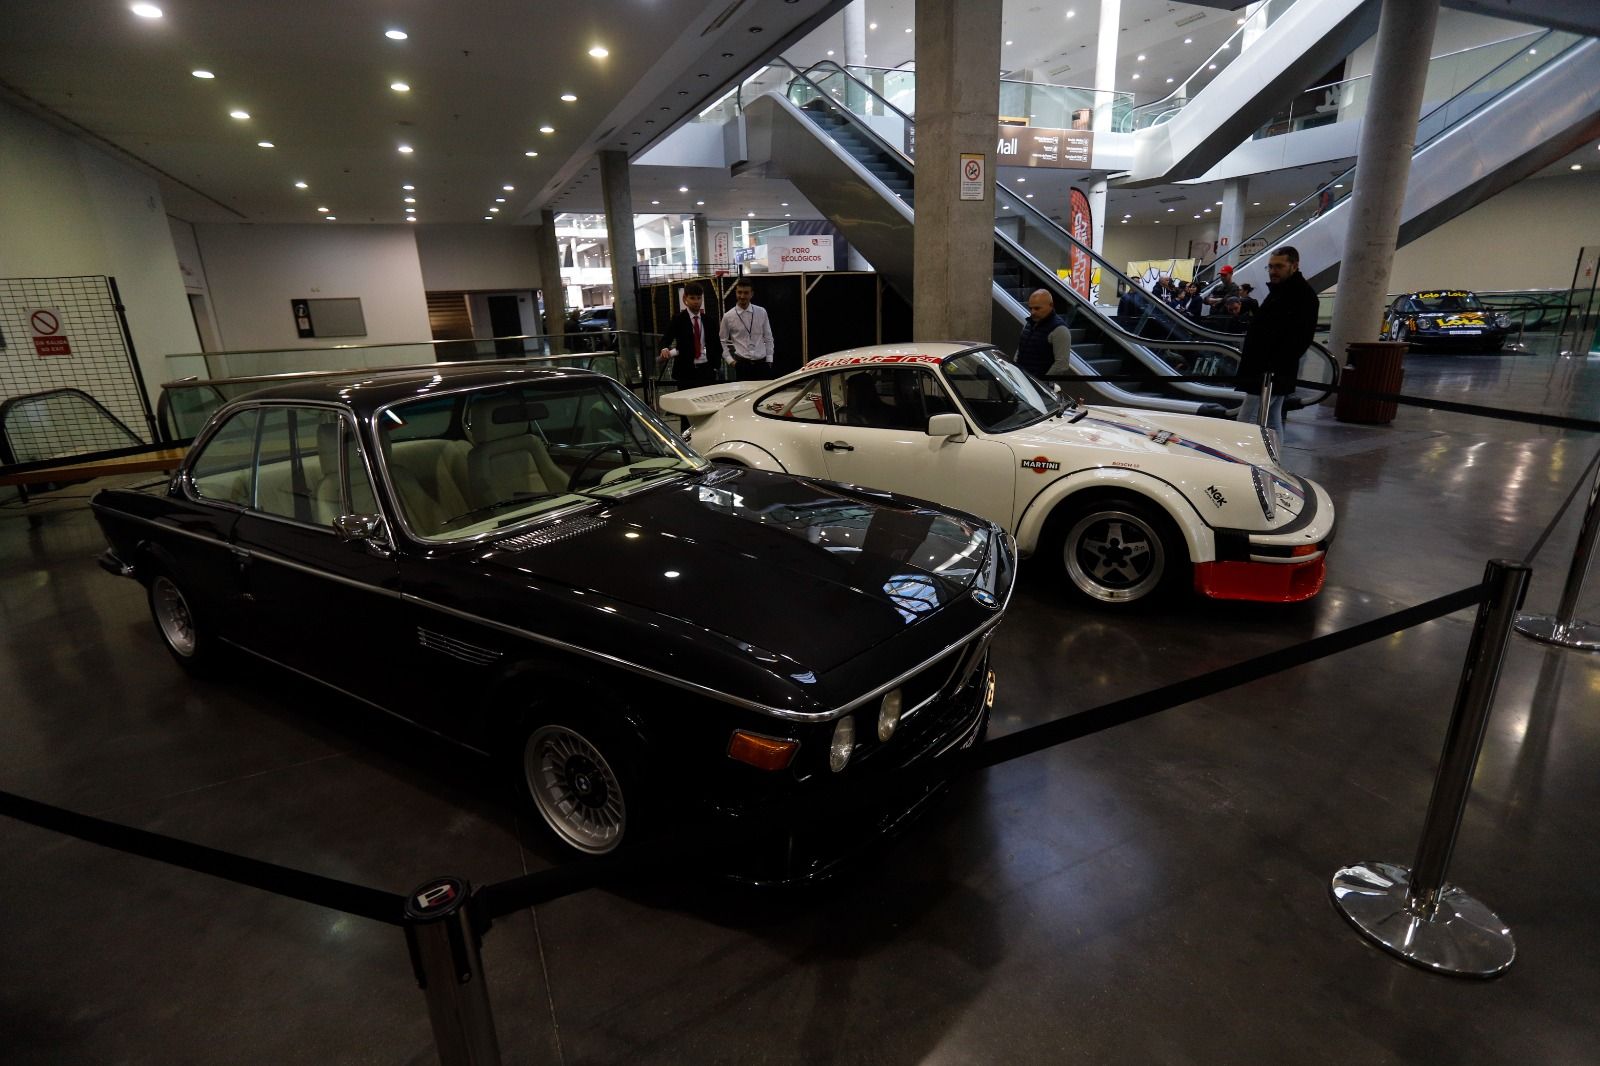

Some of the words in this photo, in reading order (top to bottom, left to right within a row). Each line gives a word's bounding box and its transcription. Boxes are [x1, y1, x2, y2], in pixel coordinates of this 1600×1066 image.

[781, 254, 822, 262] ECOLÓGICOS
[1022, 460, 1059, 470] MARTINI
[1207, 485, 1228, 507] NGK
